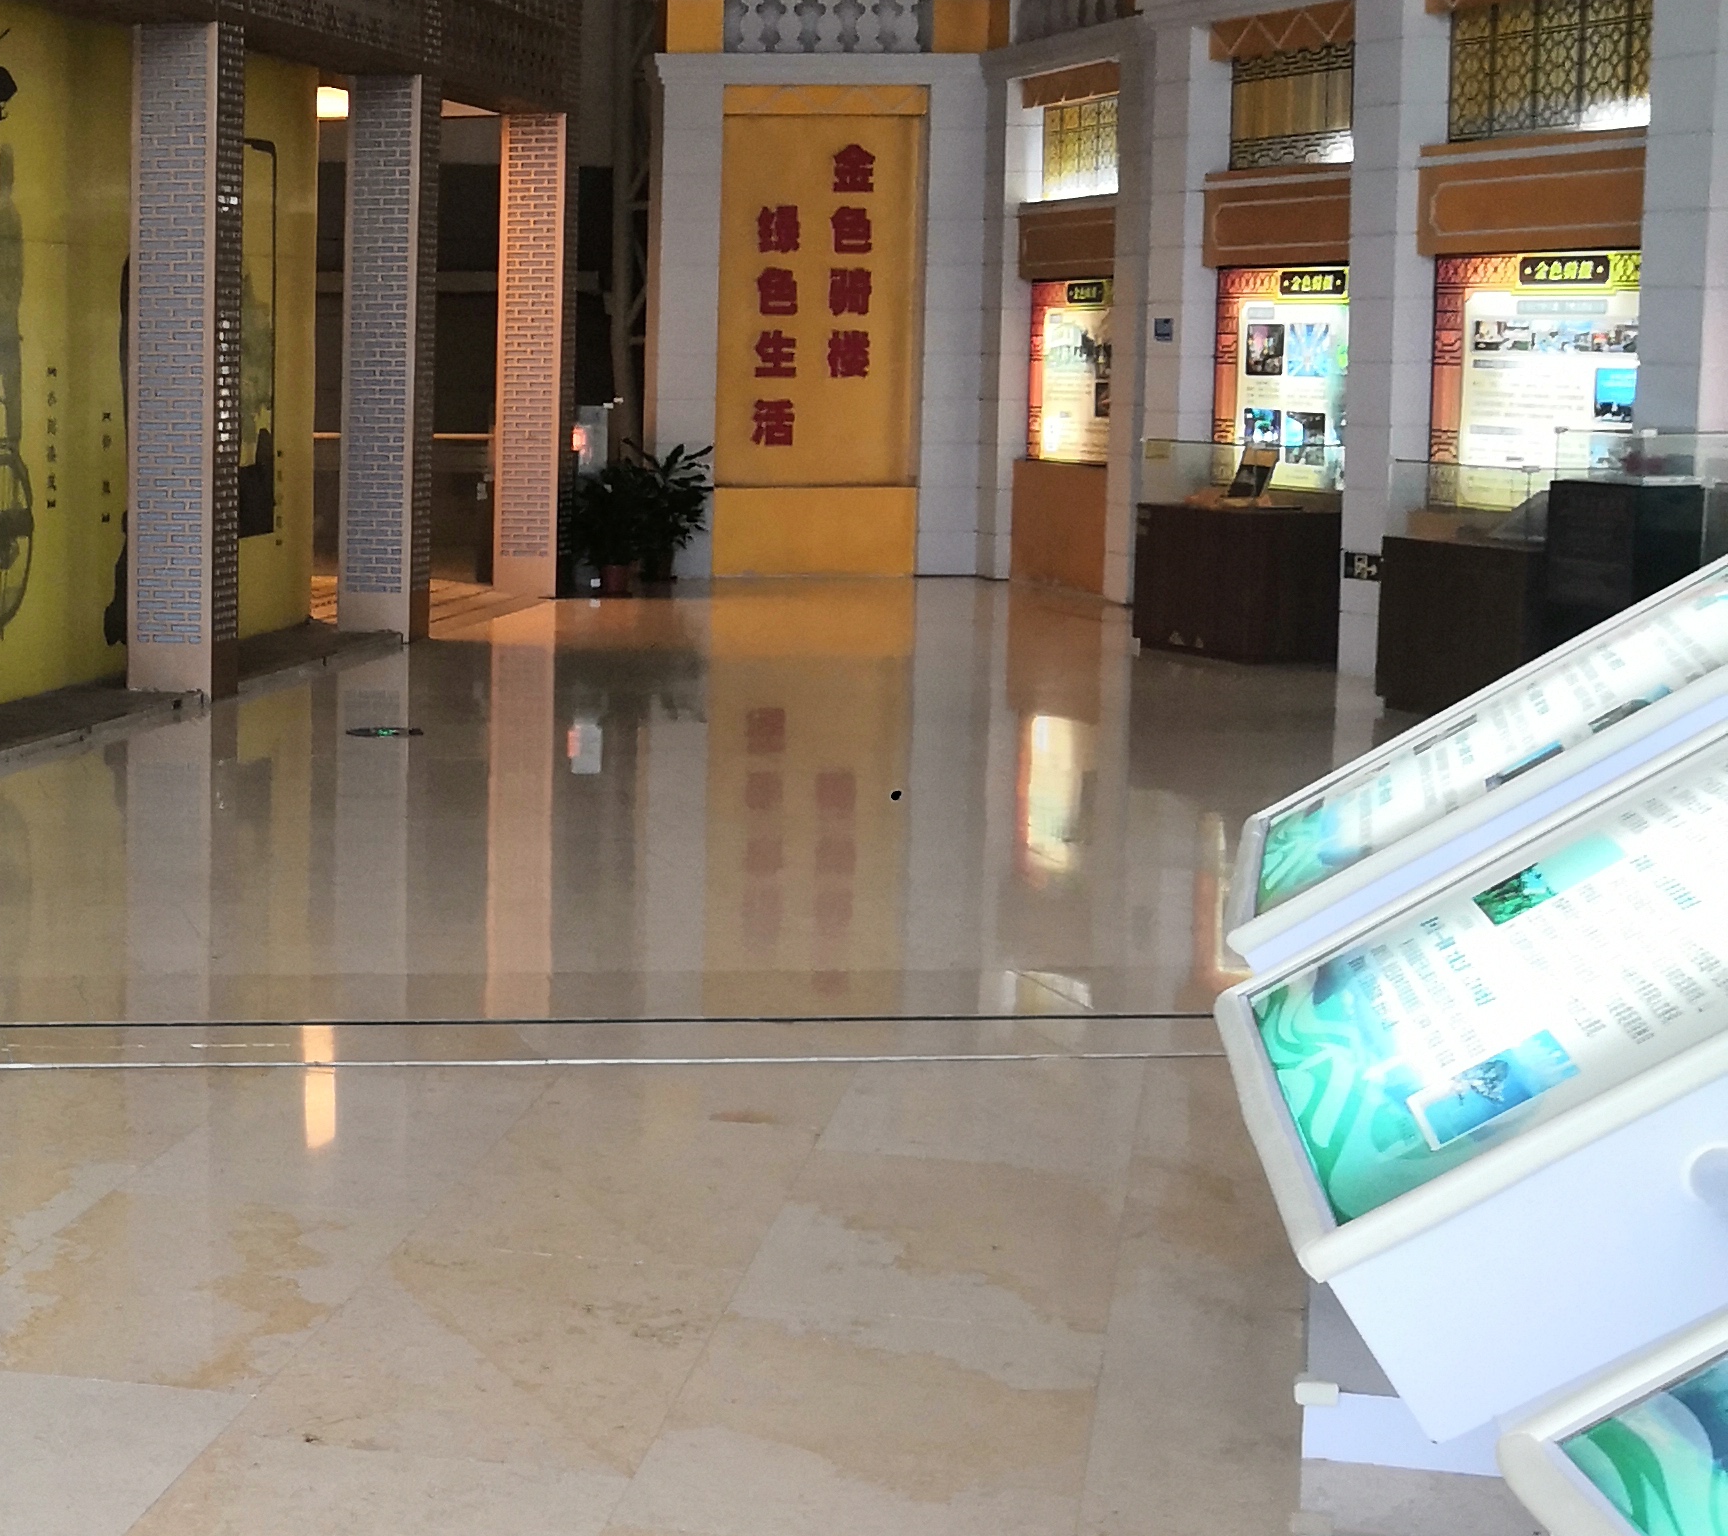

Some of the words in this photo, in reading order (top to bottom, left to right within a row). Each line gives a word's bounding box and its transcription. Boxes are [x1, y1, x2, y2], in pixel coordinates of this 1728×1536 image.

[751, 205, 801, 447] 绿色生活
[827, 143, 876, 378] 金色骑楼
